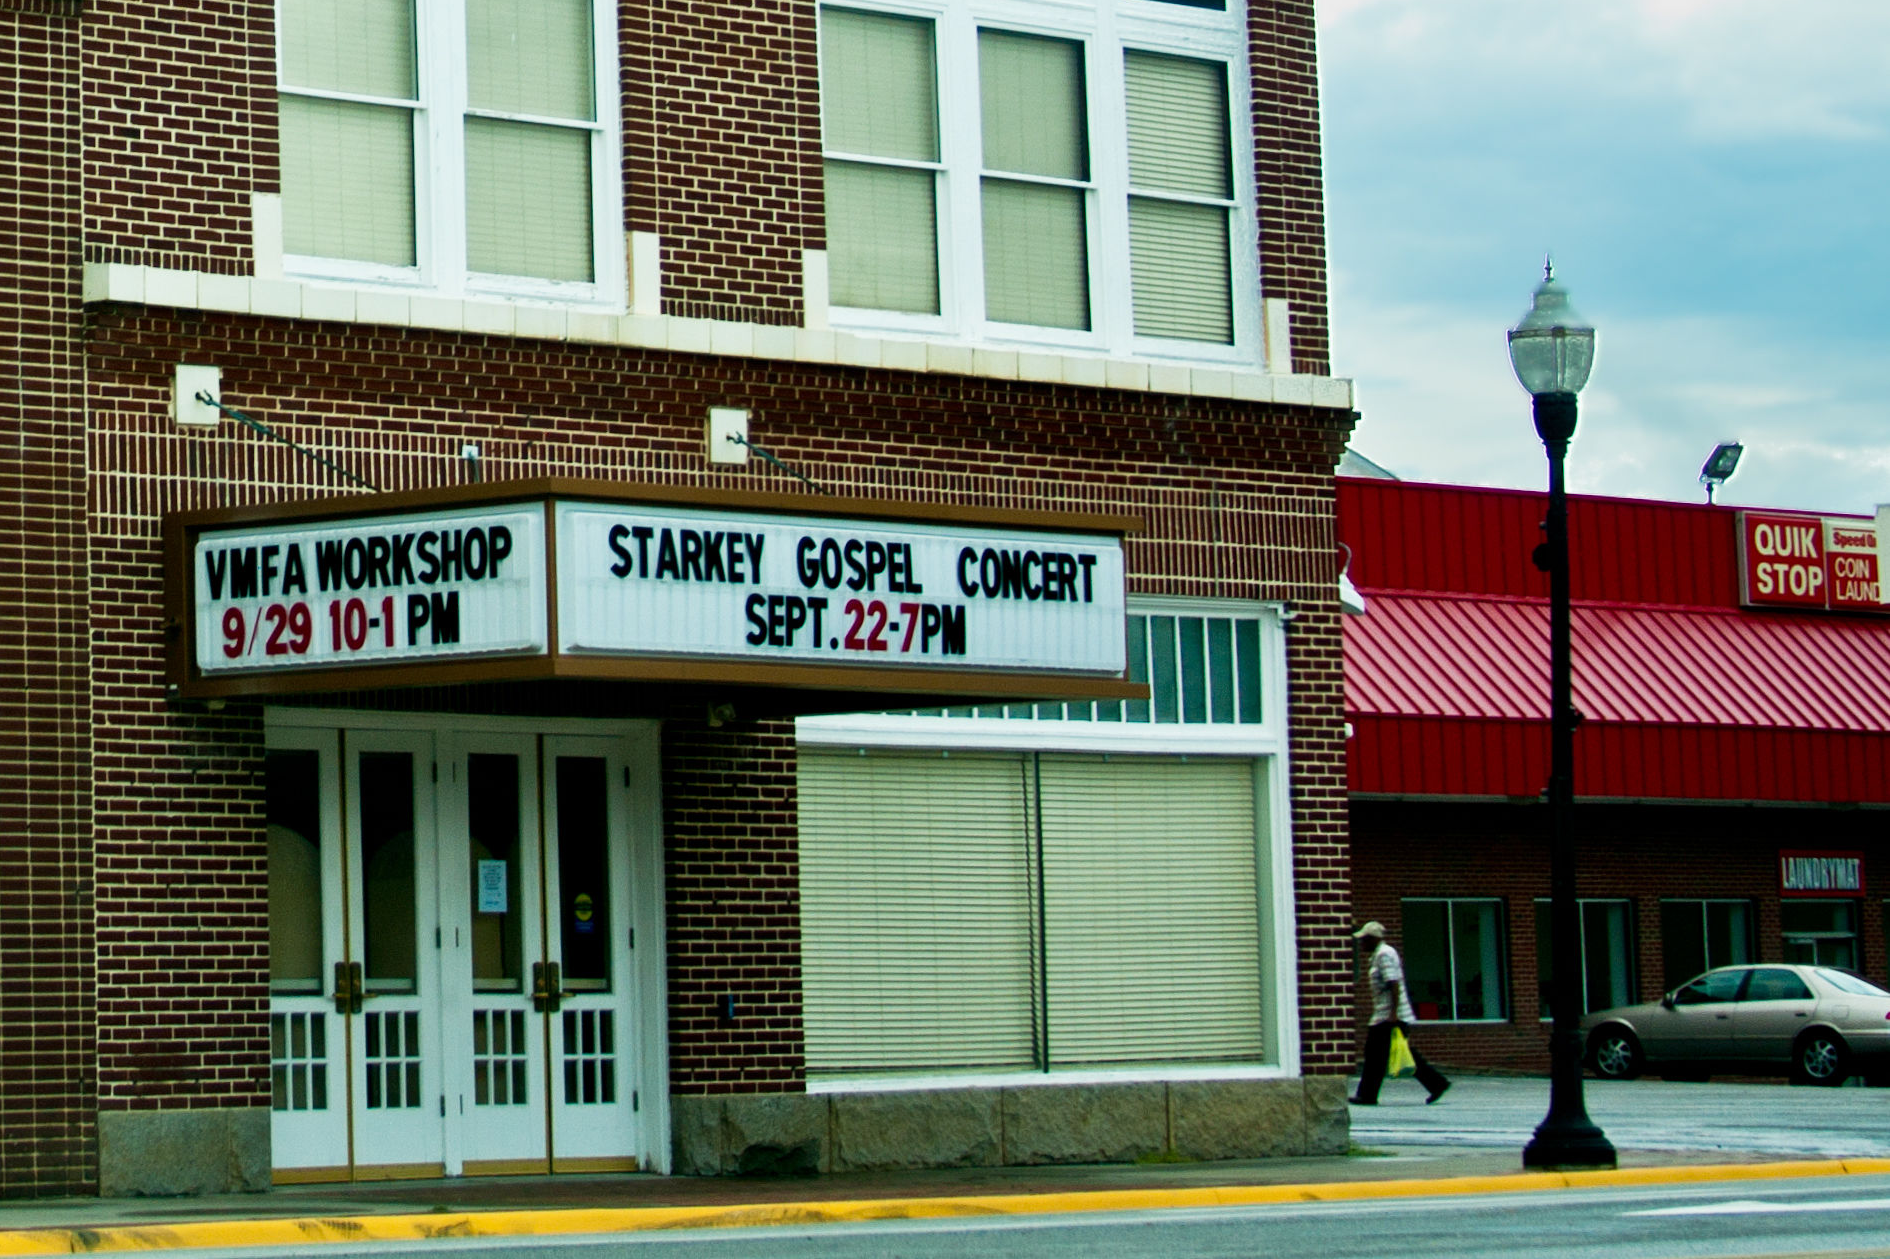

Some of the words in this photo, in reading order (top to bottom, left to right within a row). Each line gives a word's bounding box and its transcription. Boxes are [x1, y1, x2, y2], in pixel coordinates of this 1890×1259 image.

[205, 543, 308, 600] VMFA
[315, 526, 512, 592] WORKSHOP
[609, 524, 764, 584] STARKEY
[796, 536, 923, 594] GOSPEL
[957, 546, 1097, 603] CONCERT
[1754, 523, 1818, 558] QUIK
[1757, 562, 1823, 596] STOP
[1834, 556, 1870, 578] COIN
[222, 602, 312, 659] 9/29
[329, 596, 394, 651] 10-1
[407, 591, 460, 646] PM
